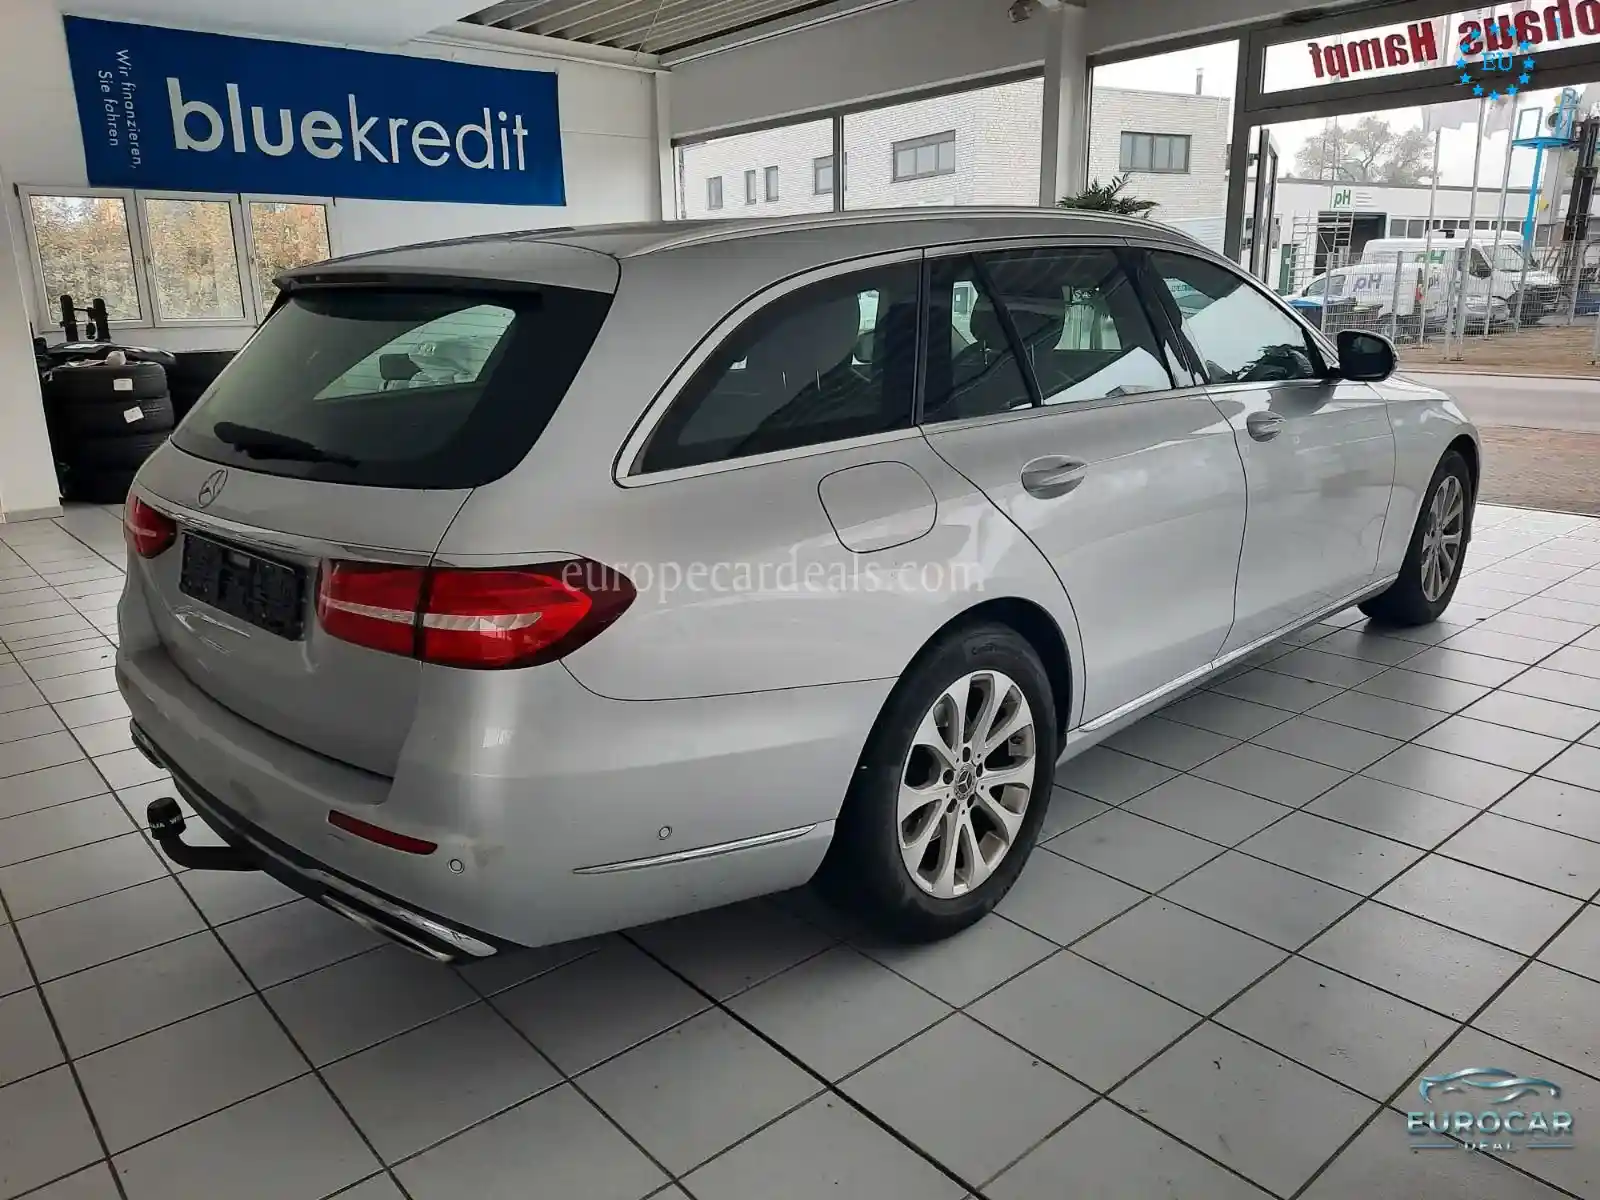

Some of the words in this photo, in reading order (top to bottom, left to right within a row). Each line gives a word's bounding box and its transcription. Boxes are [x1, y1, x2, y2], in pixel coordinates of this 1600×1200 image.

[98, 69, 114, 93] Sie
[116, 48, 132, 77] Wir
[103, 98, 121, 146] fahren
[121, 82, 141, 169] finanzieren,
[166, 76, 529, 171] bluekredit
[1333, 189, 1352, 208] pH
